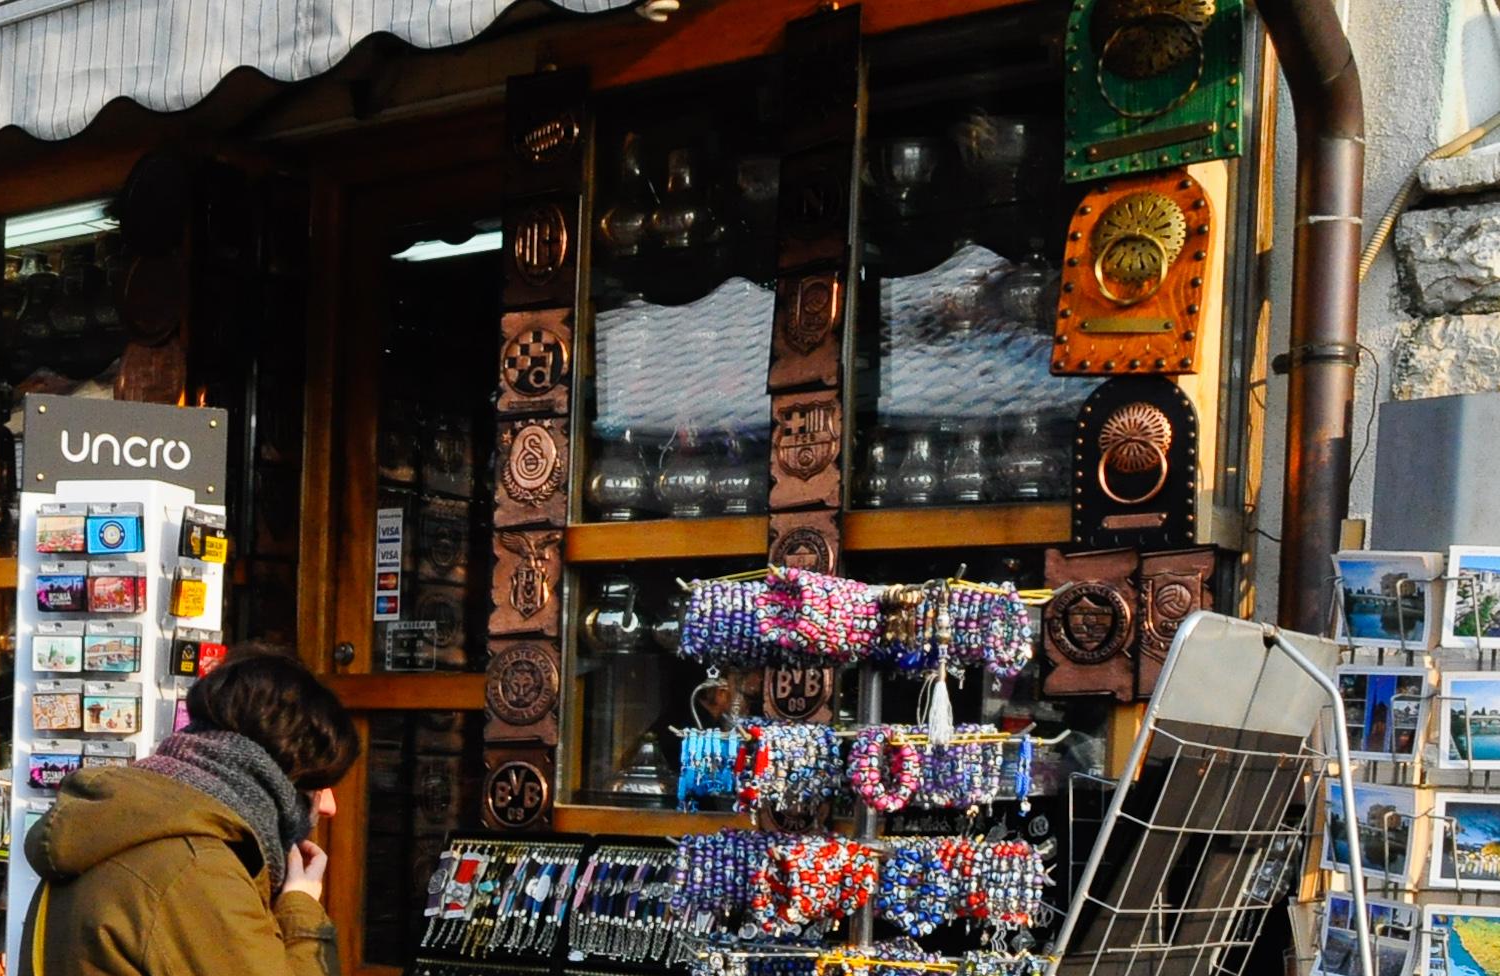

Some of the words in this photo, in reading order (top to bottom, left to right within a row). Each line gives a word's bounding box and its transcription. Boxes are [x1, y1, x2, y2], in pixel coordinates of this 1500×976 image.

[60, 429, 192, 471] uncro
[381, 525, 399, 537] VISA
[380, 549, 398, 561] VISA
[788, 697, 806, 712] 09
